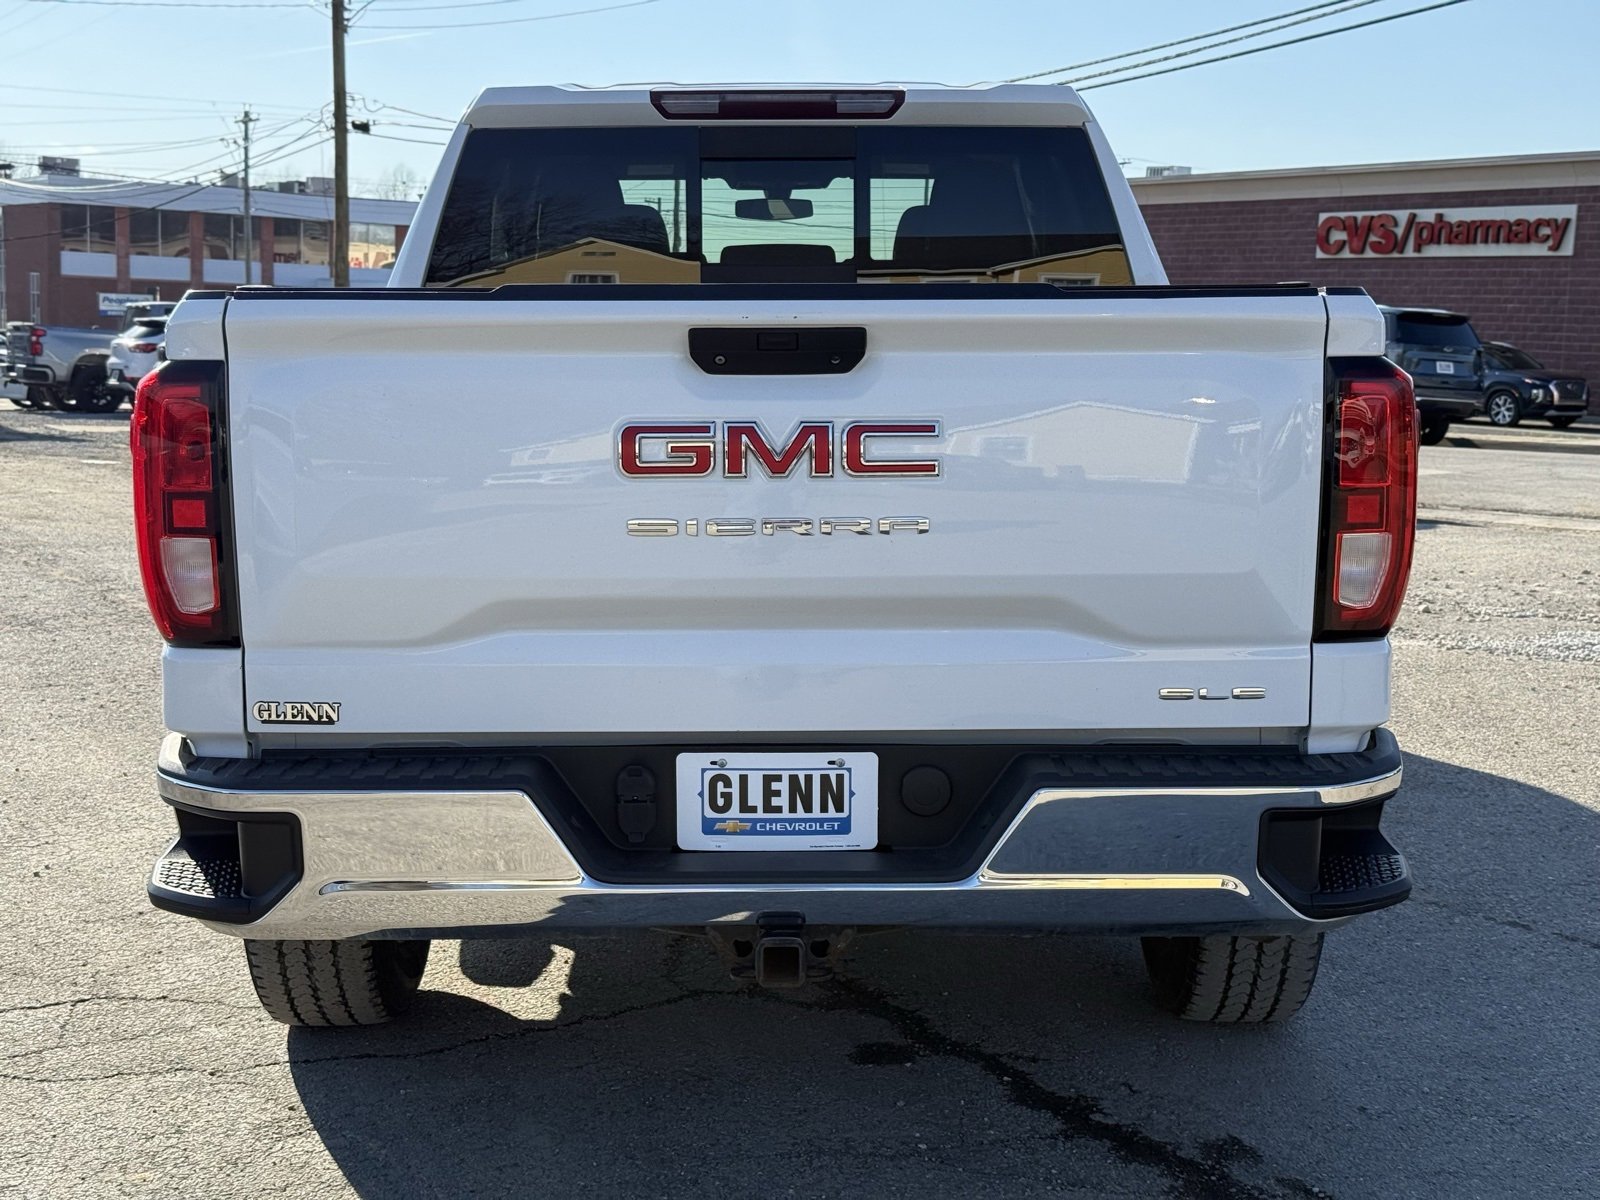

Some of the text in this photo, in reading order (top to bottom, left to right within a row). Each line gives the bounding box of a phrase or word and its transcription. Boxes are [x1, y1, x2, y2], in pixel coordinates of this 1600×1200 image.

[1316, 212, 1571, 255] CVS/pharmacy
[618, 420, 941, 478] GMC
[626, 516, 930, 537] SIERRA
[1158, 687, 1267, 700] SLE
[252, 701, 341, 725] GLENN
[708, 773, 845, 814] GLENN
[756, 822, 841, 831] CHEVROLET
